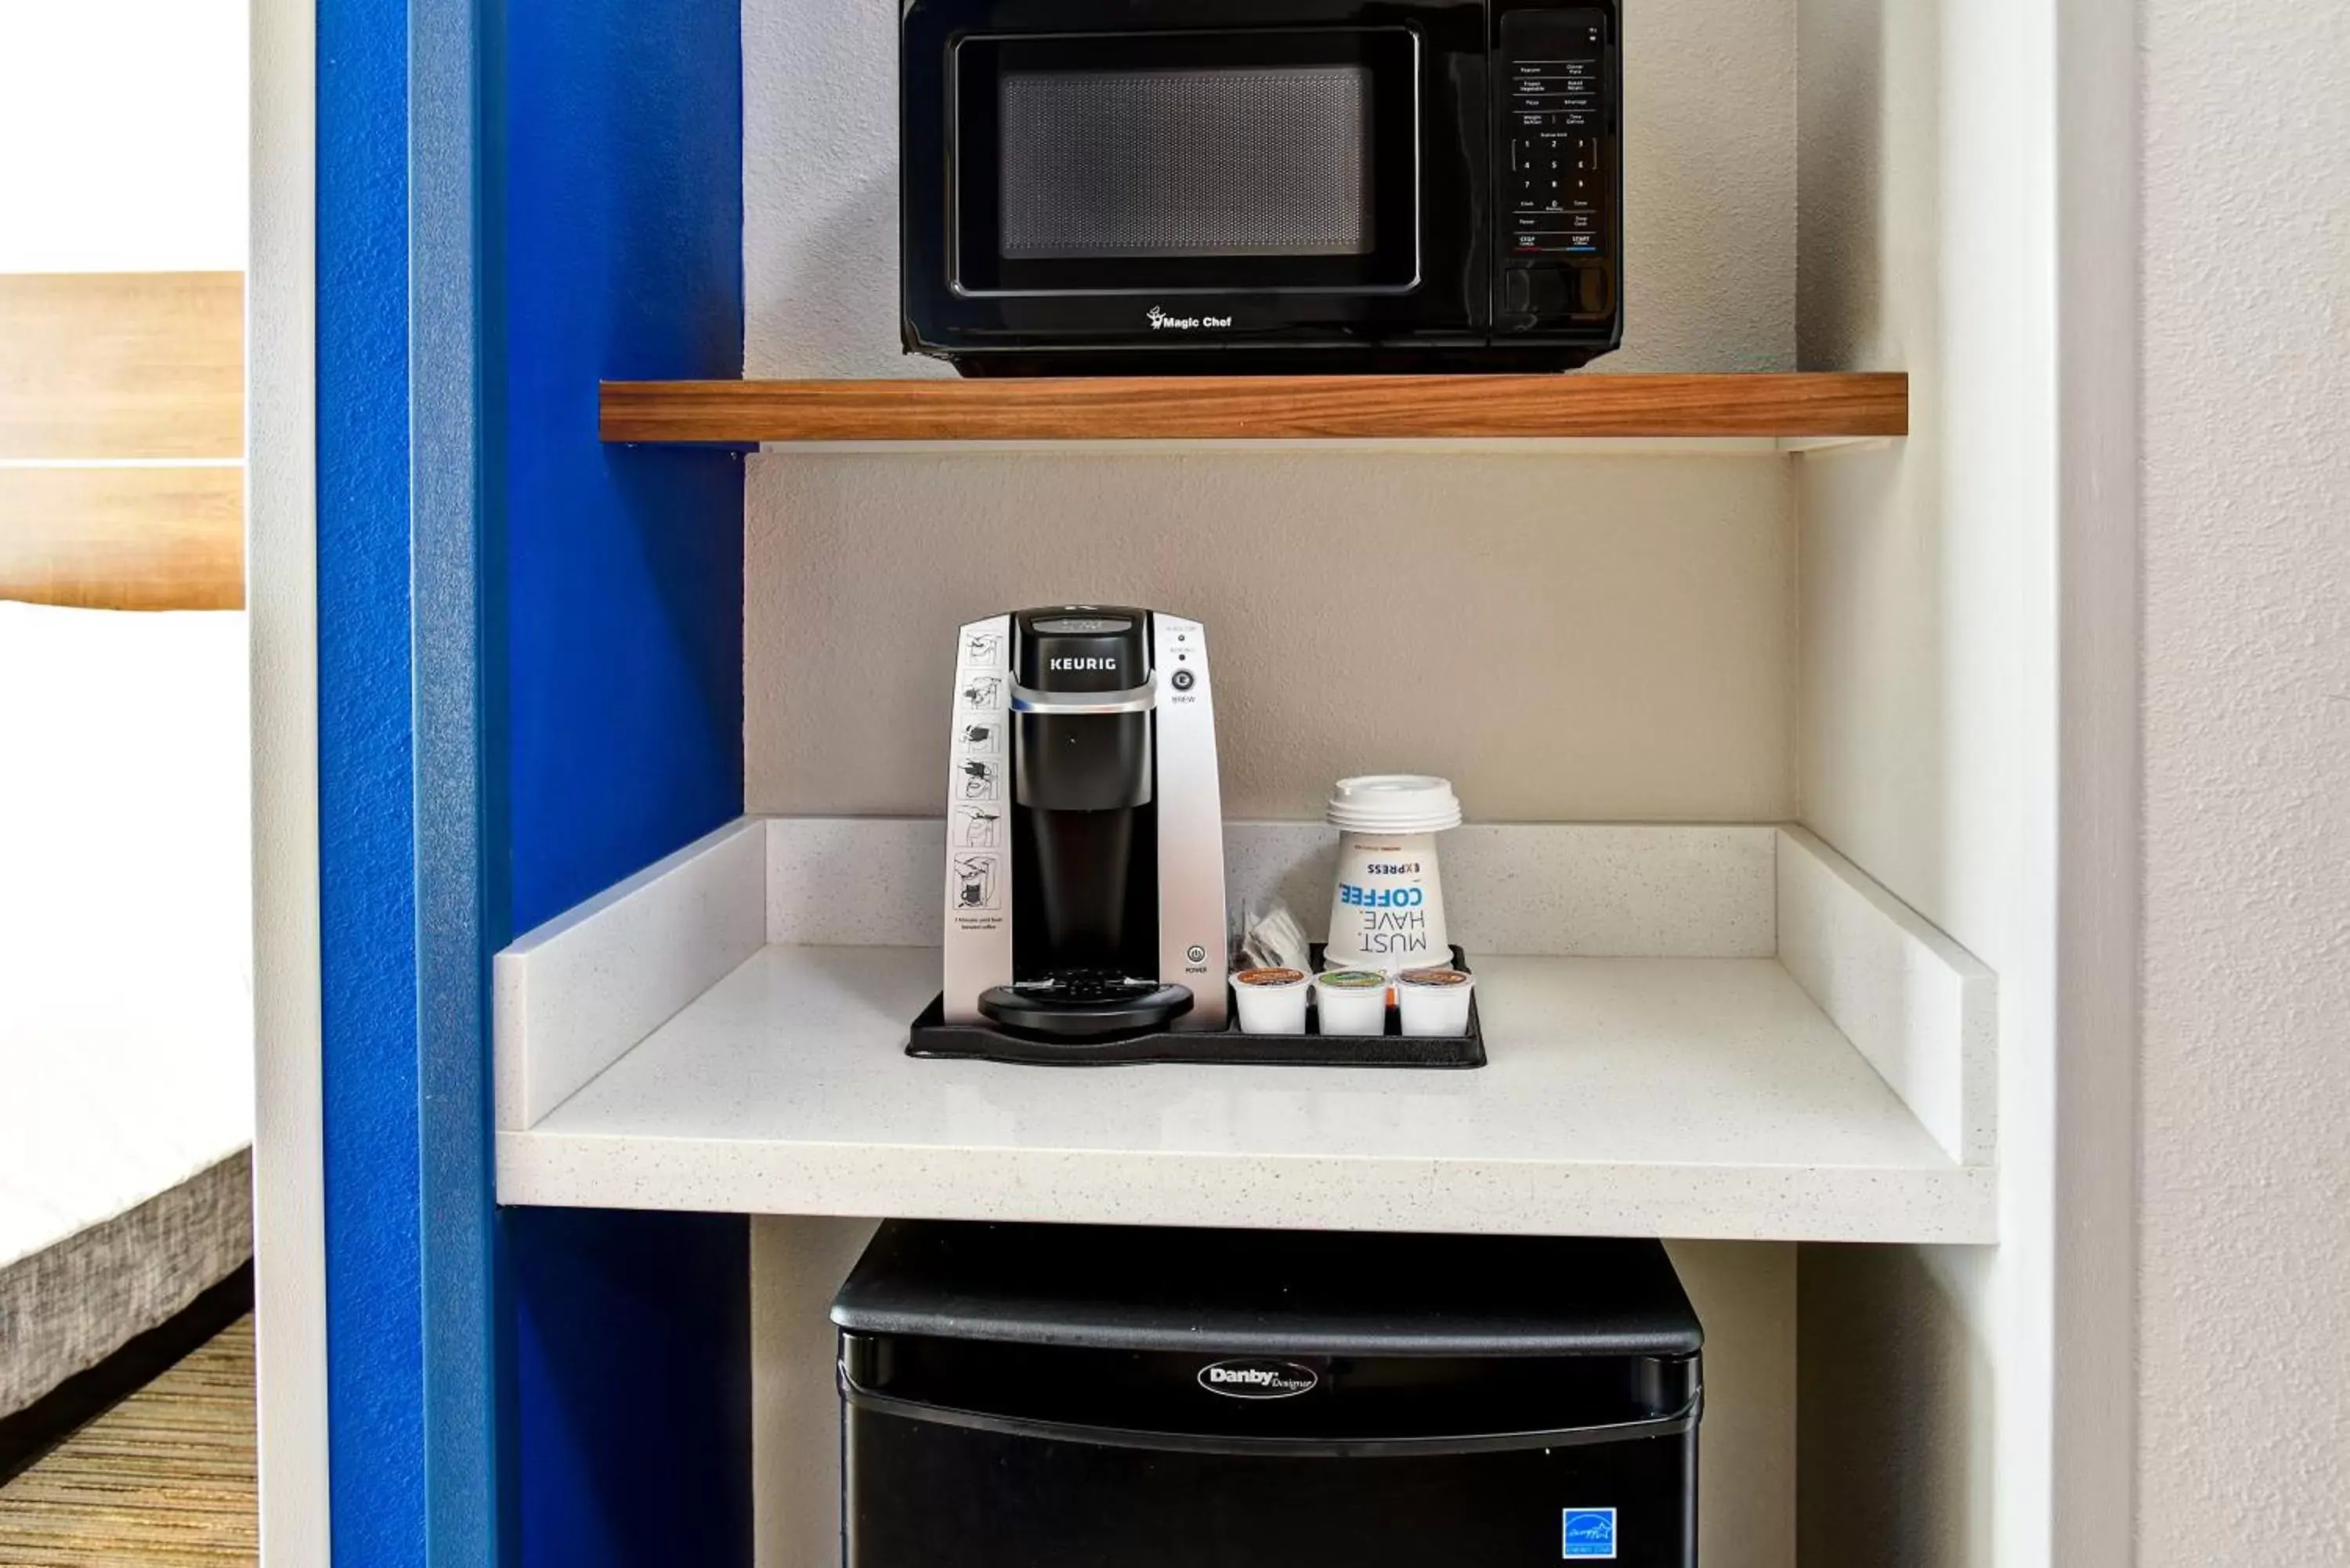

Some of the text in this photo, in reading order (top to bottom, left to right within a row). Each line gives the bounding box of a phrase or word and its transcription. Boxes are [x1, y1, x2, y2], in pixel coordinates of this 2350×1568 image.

[1163, 316, 1232, 329] Magic Chef
[1050, 657, 1116, 670] KEURIG
[1367, 863, 1420, 875] EXPRESS
[1359, 910, 1425, 931] HAVE.
[1358, 932, 1426, 953] MUST.
[1210, 1368, 1272, 1386] Danby
